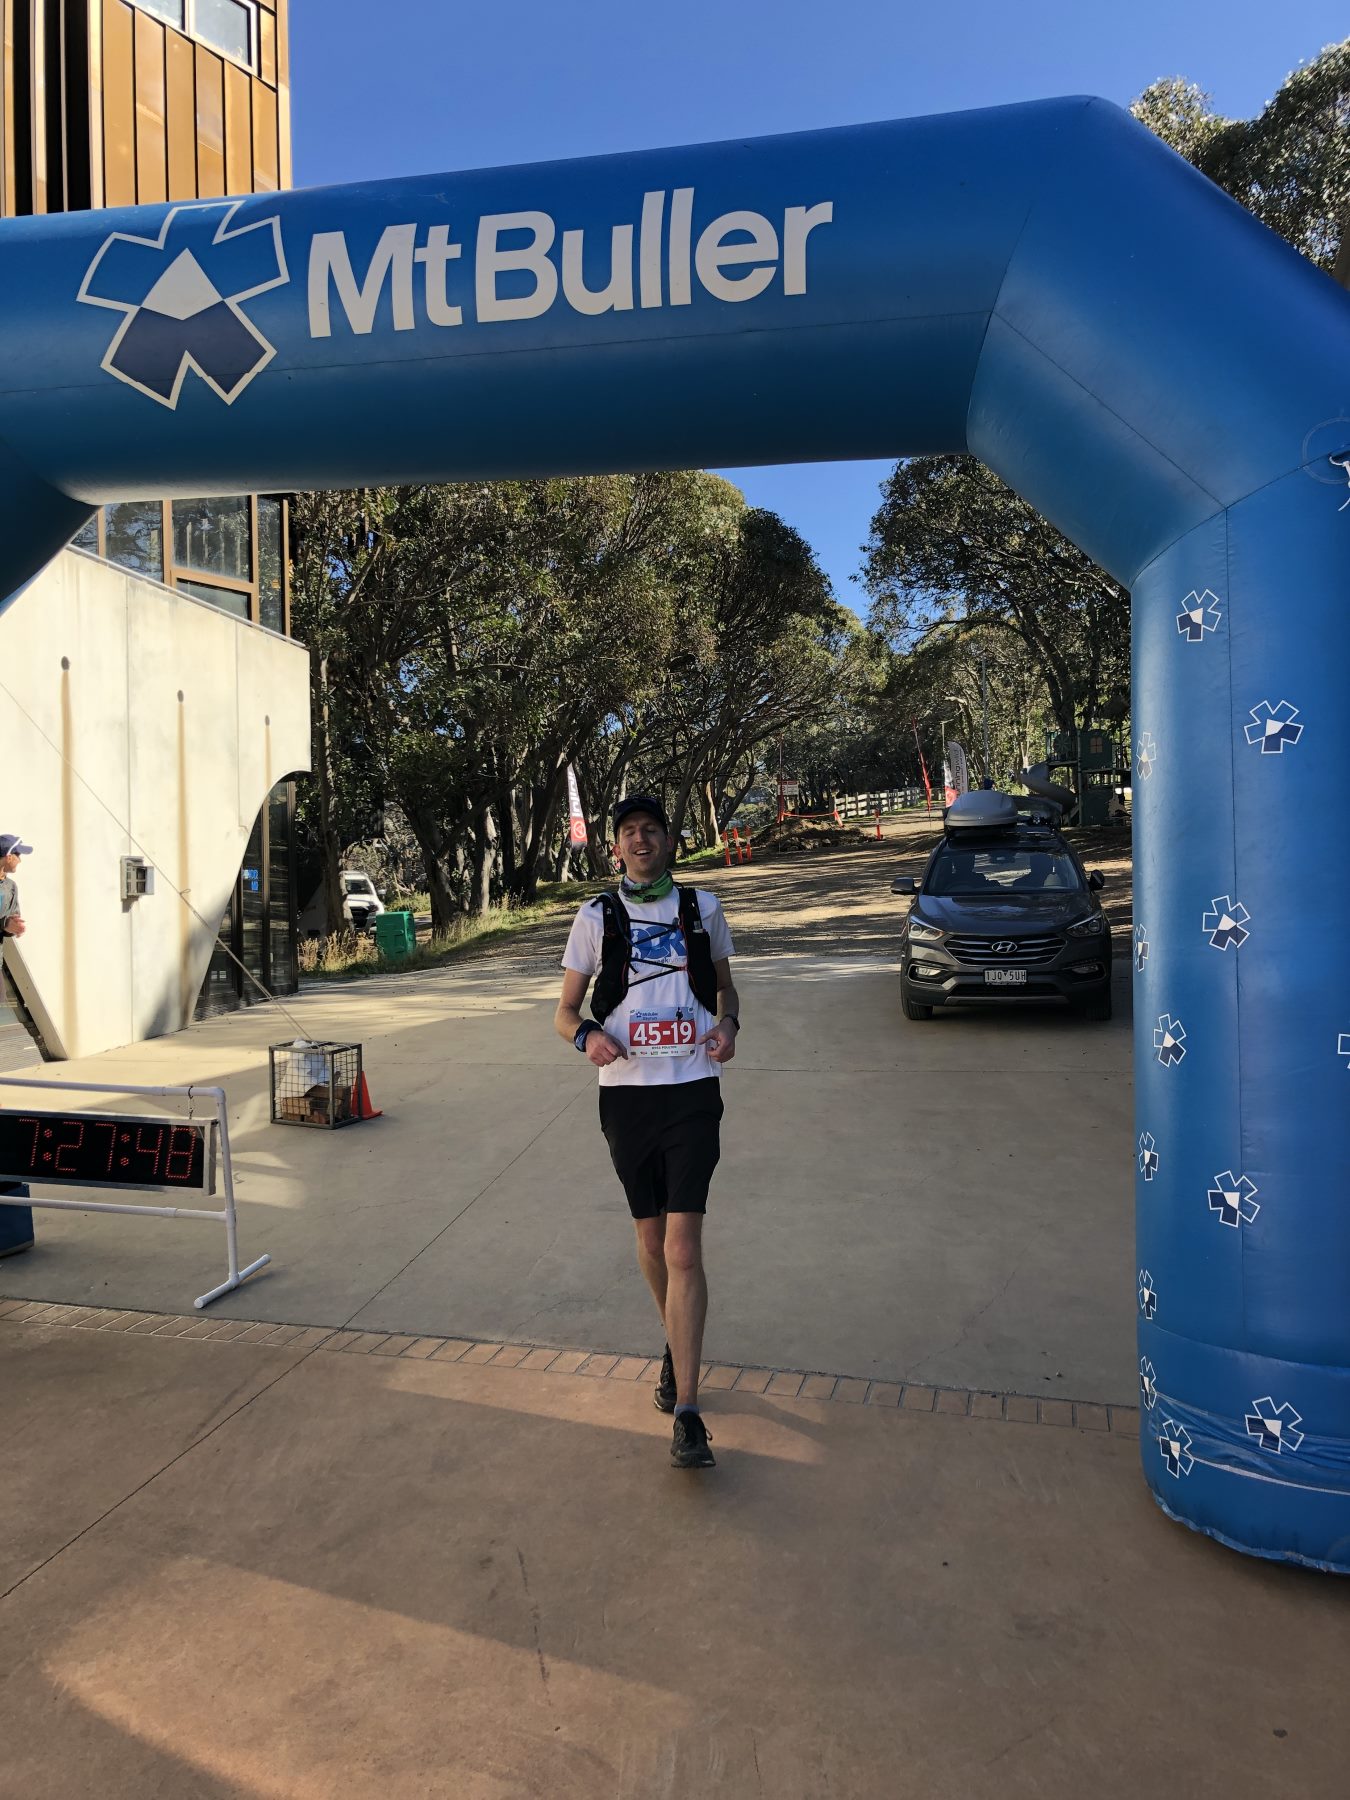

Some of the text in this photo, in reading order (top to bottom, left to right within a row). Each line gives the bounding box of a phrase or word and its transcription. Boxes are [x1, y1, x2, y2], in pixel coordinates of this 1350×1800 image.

[475, 187, 834, 324] Buller
[632, 1021, 693, 1045] 45-19
[18, 1118, 197, 1179] 7:27:48
